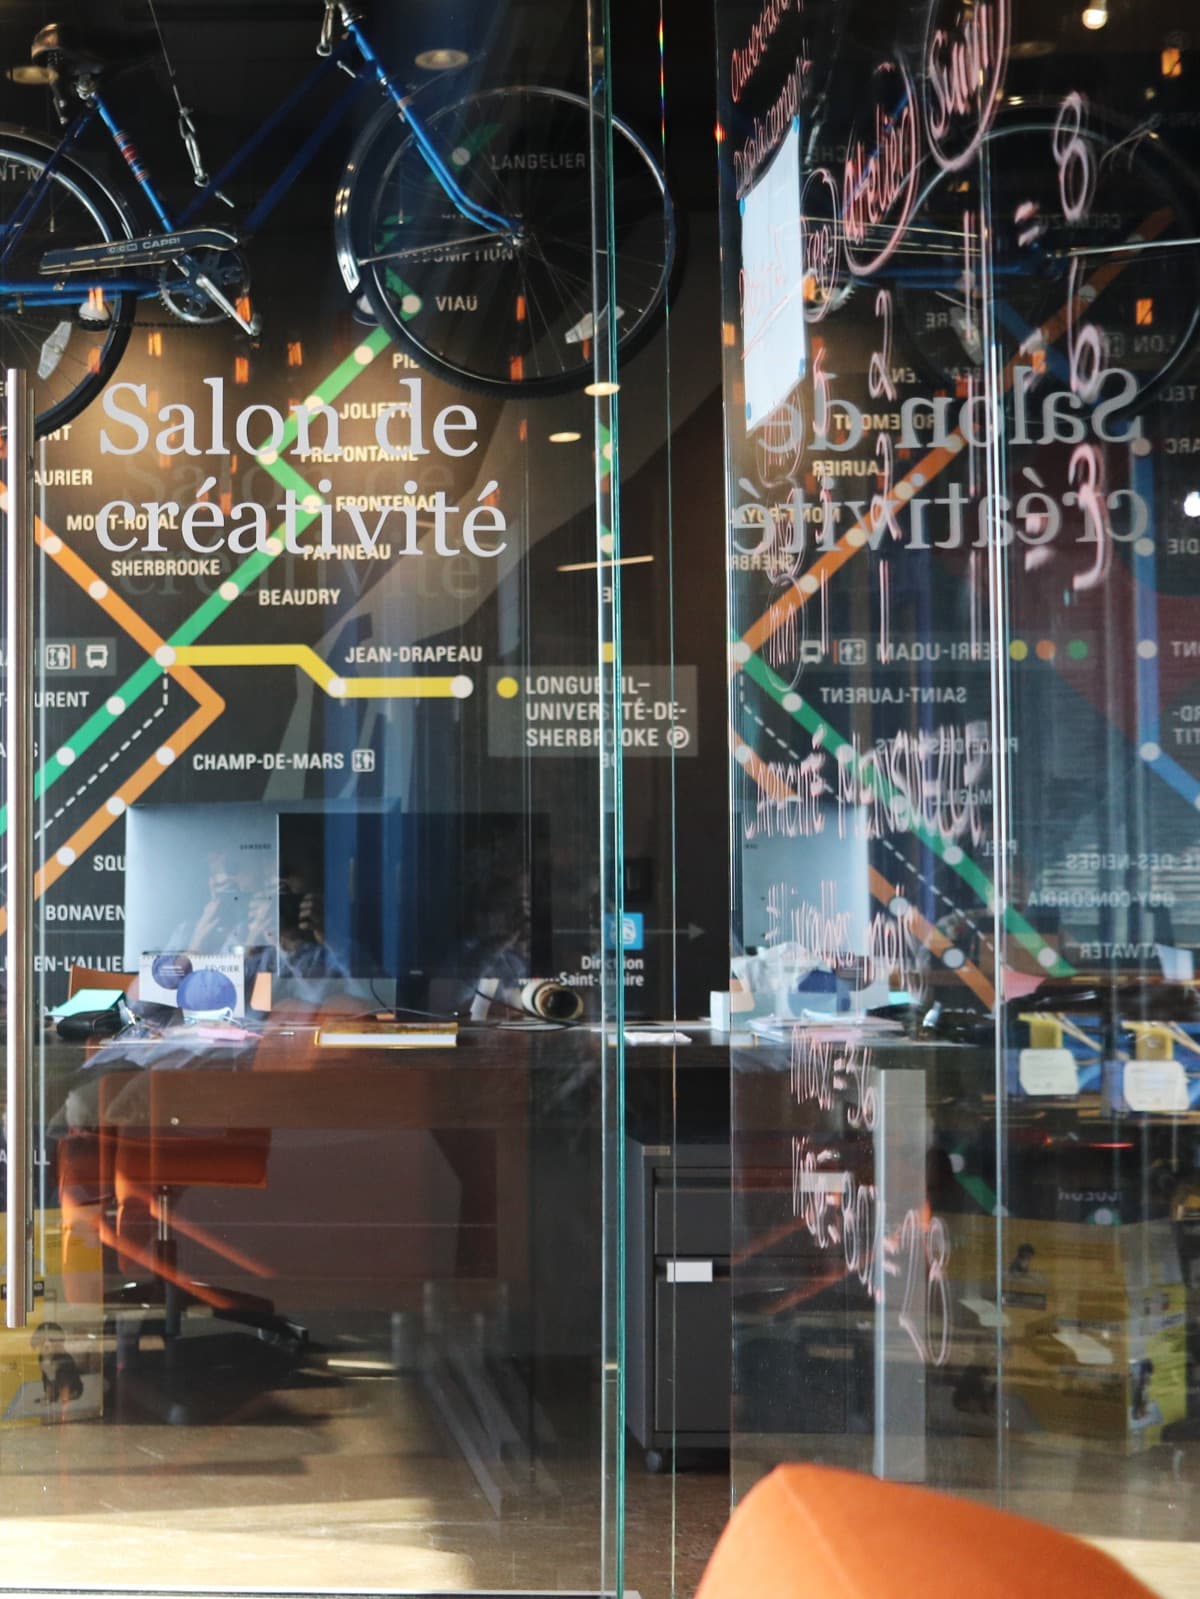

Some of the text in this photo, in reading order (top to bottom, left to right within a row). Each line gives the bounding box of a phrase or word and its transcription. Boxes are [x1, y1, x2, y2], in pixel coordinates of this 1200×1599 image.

[491, 153, 586, 171] LANGELIER
[435, 296, 478, 312] VIAU
[100, 376, 479, 458] Salon de
[34, 468, 94, 486] AURIER
[94, 475, 508, 558] créativité
[111, 559, 220, 577] SHERBROOKE
[258, 588, 341, 606] BEAUDRY
[345, 646, 483, 664] JEAN-DRAPEAU
[192, 752, 345, 771] CHAMP-DE-MARS
[45, 904, 126, 922] BONAVEN
